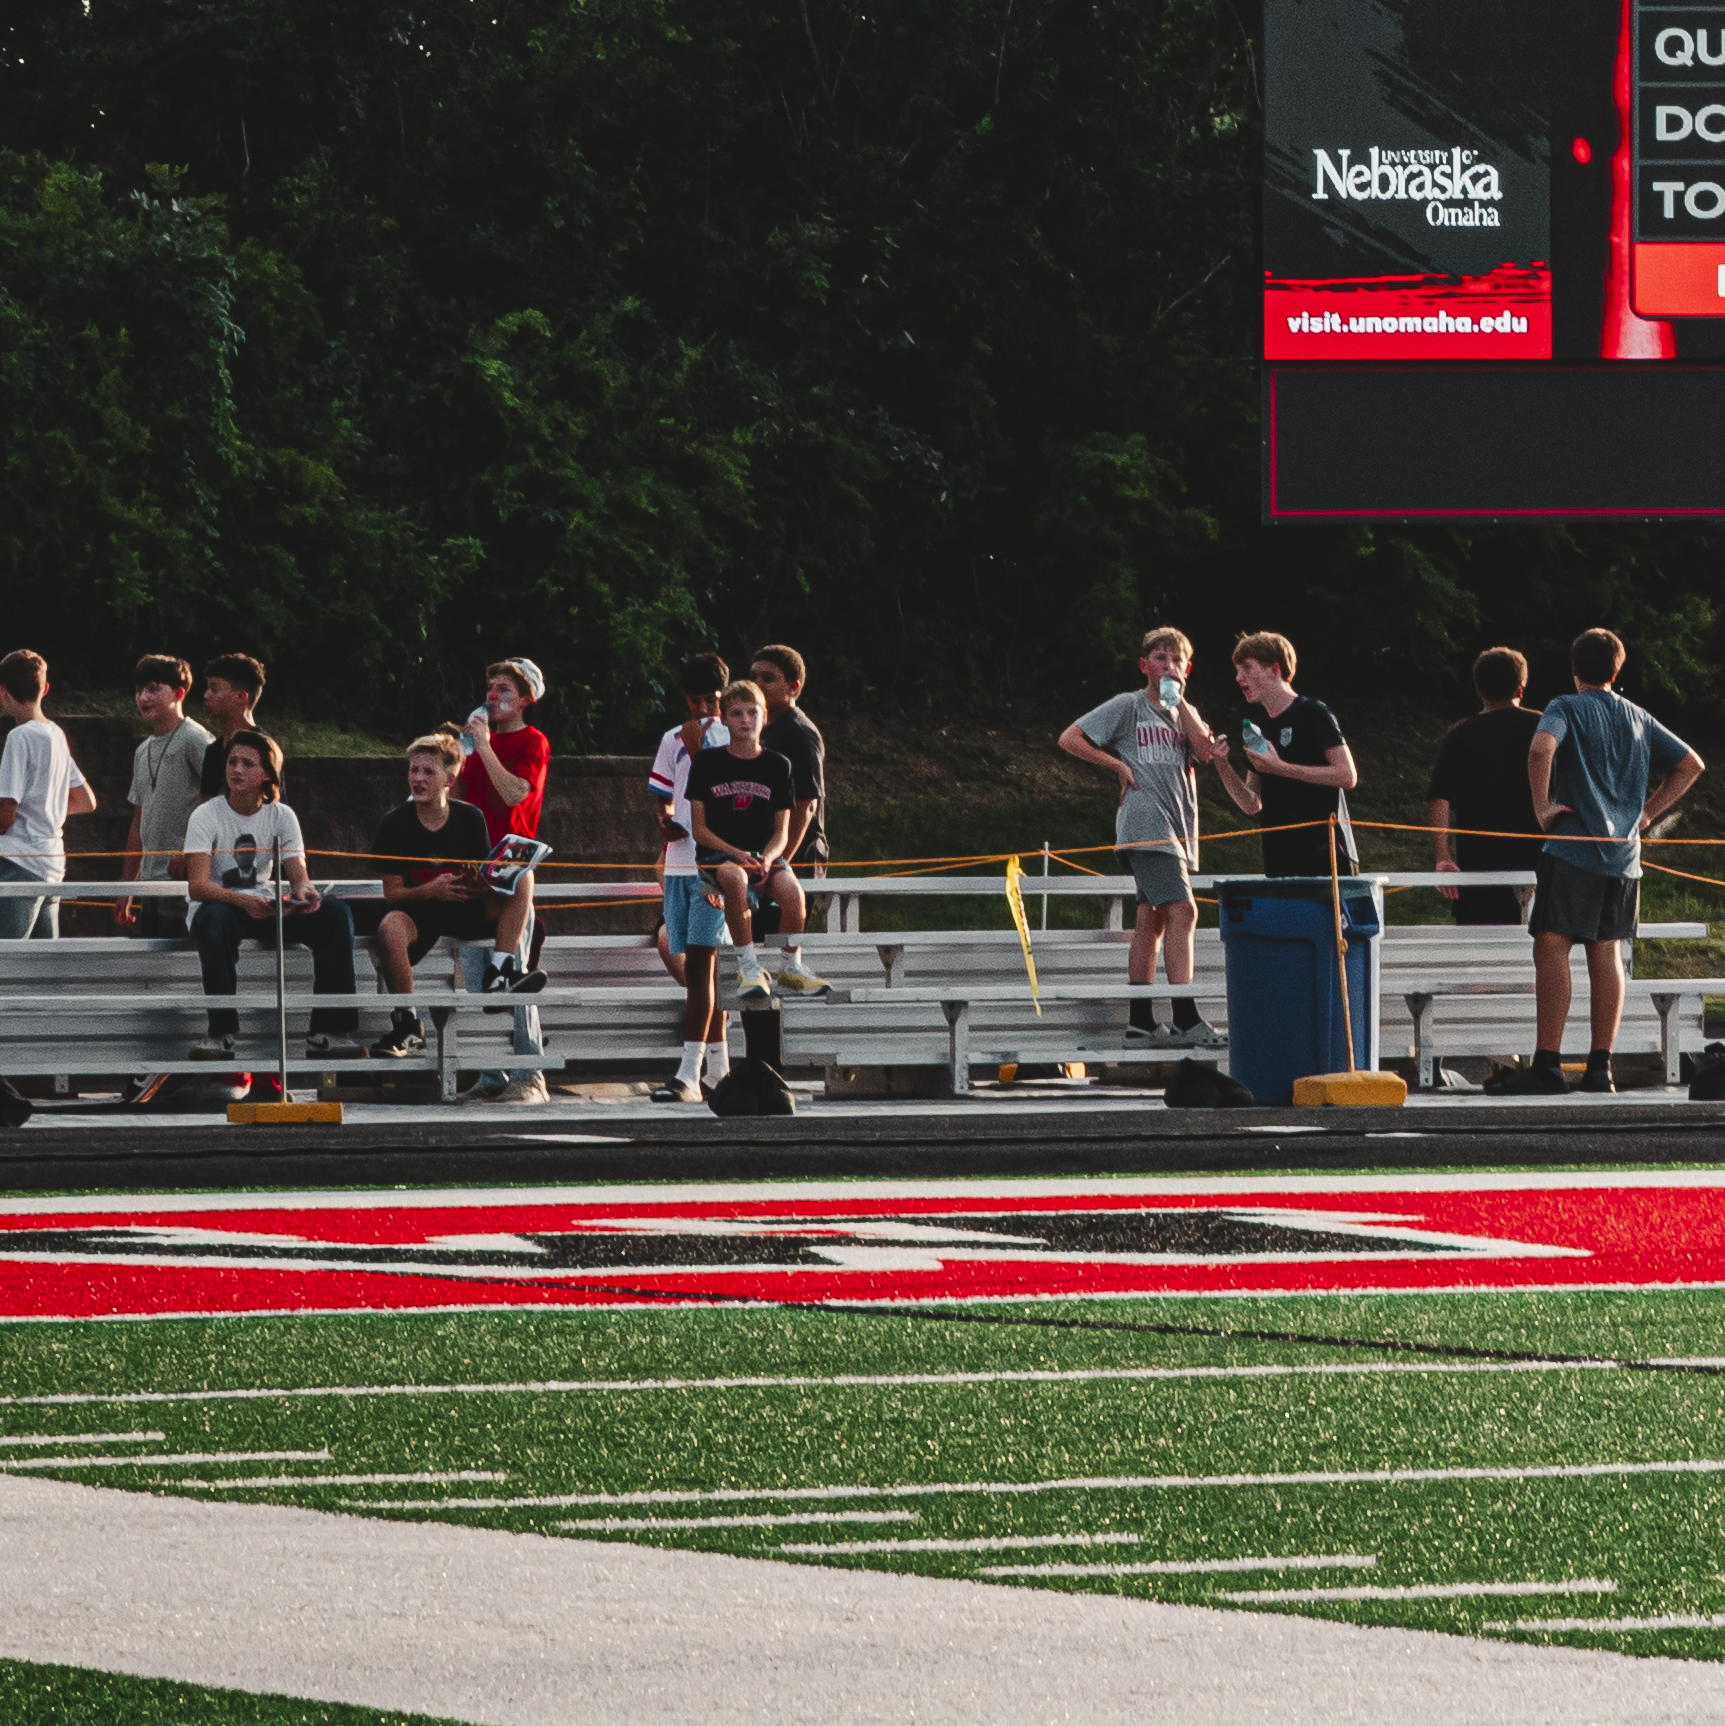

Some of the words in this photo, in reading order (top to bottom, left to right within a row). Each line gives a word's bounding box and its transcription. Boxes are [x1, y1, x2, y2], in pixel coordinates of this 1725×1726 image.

[1311, 145, 1503, 201] Nebraska
[1425, 200, 1501, 227] Omaha
[1286, 309, 1528, 334] visit.unomaha.edu
